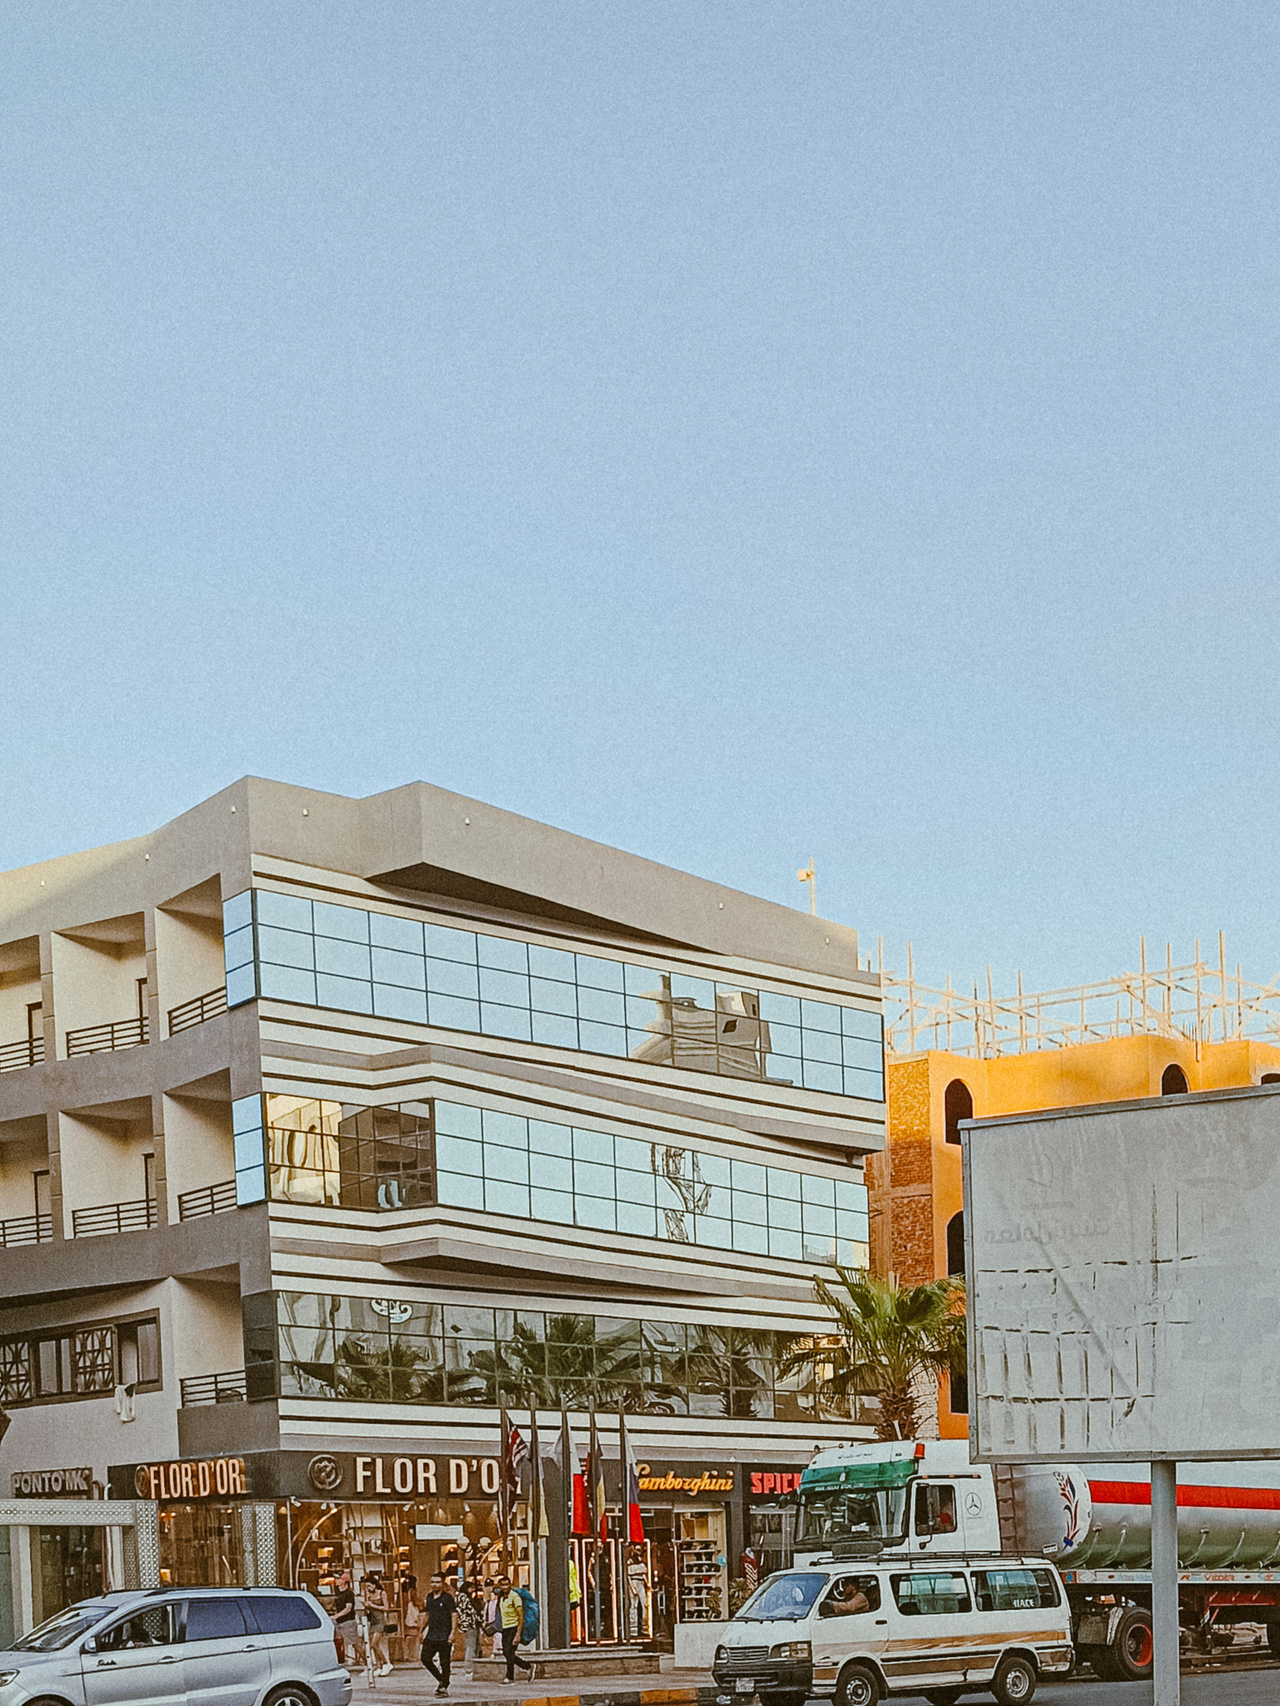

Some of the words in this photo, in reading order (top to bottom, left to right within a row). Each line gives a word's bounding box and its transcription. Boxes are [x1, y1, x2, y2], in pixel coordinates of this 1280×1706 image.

[150, 1463, 193, 1499] FLOR
[199, 1458, 243, 1494] D'OR
[356, 1456, 437, 1494] FLOR
[449, 1458, 513, 1494] D'O
